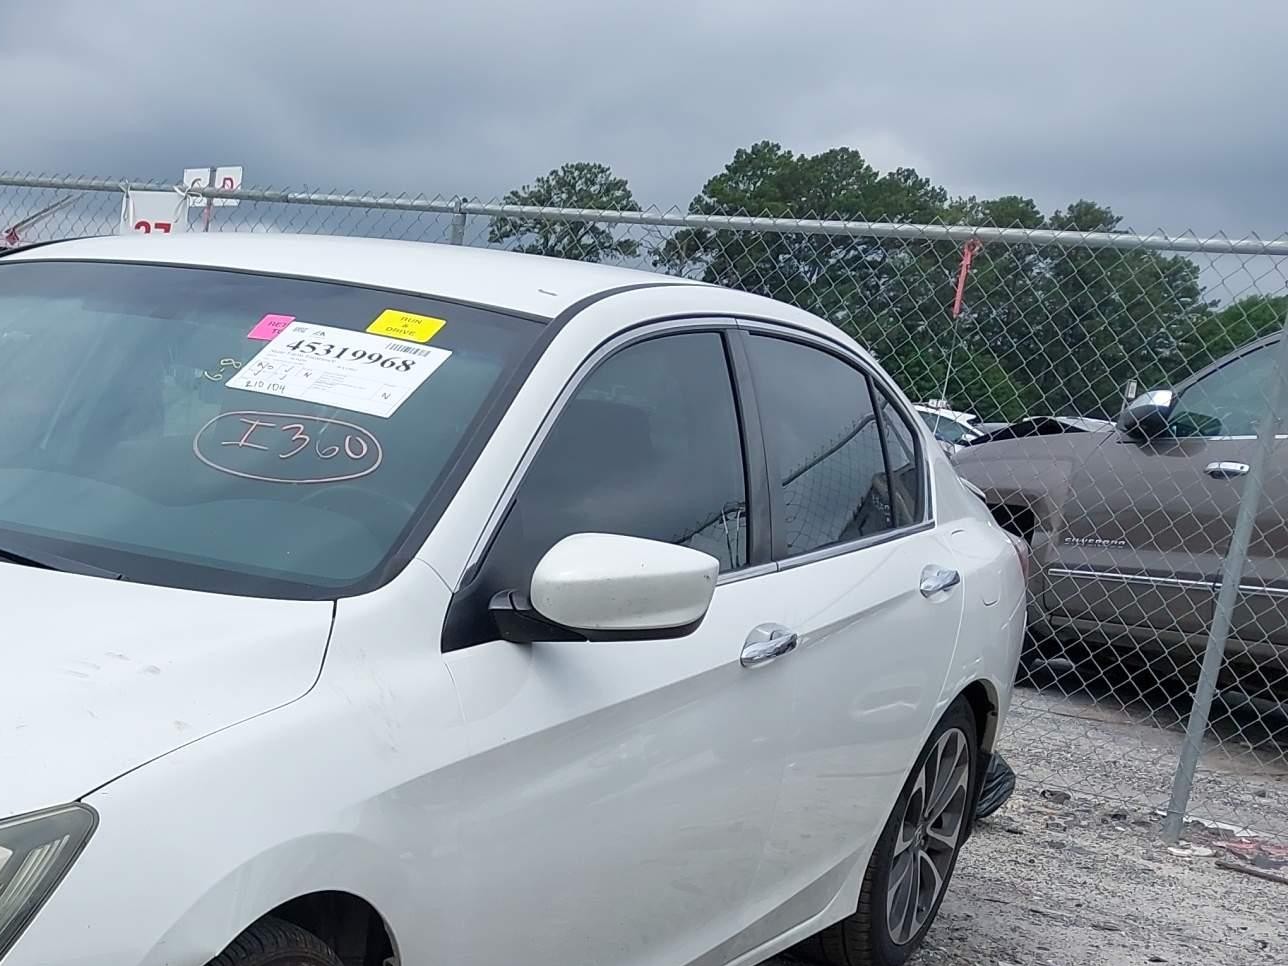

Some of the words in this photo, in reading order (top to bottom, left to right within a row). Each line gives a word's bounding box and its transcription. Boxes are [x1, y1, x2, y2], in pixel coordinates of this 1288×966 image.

[400, 316, 423, 325] RUN
[385, 326, 417, 336] DRIVE
[286, 339, 416, 372] 45319968
